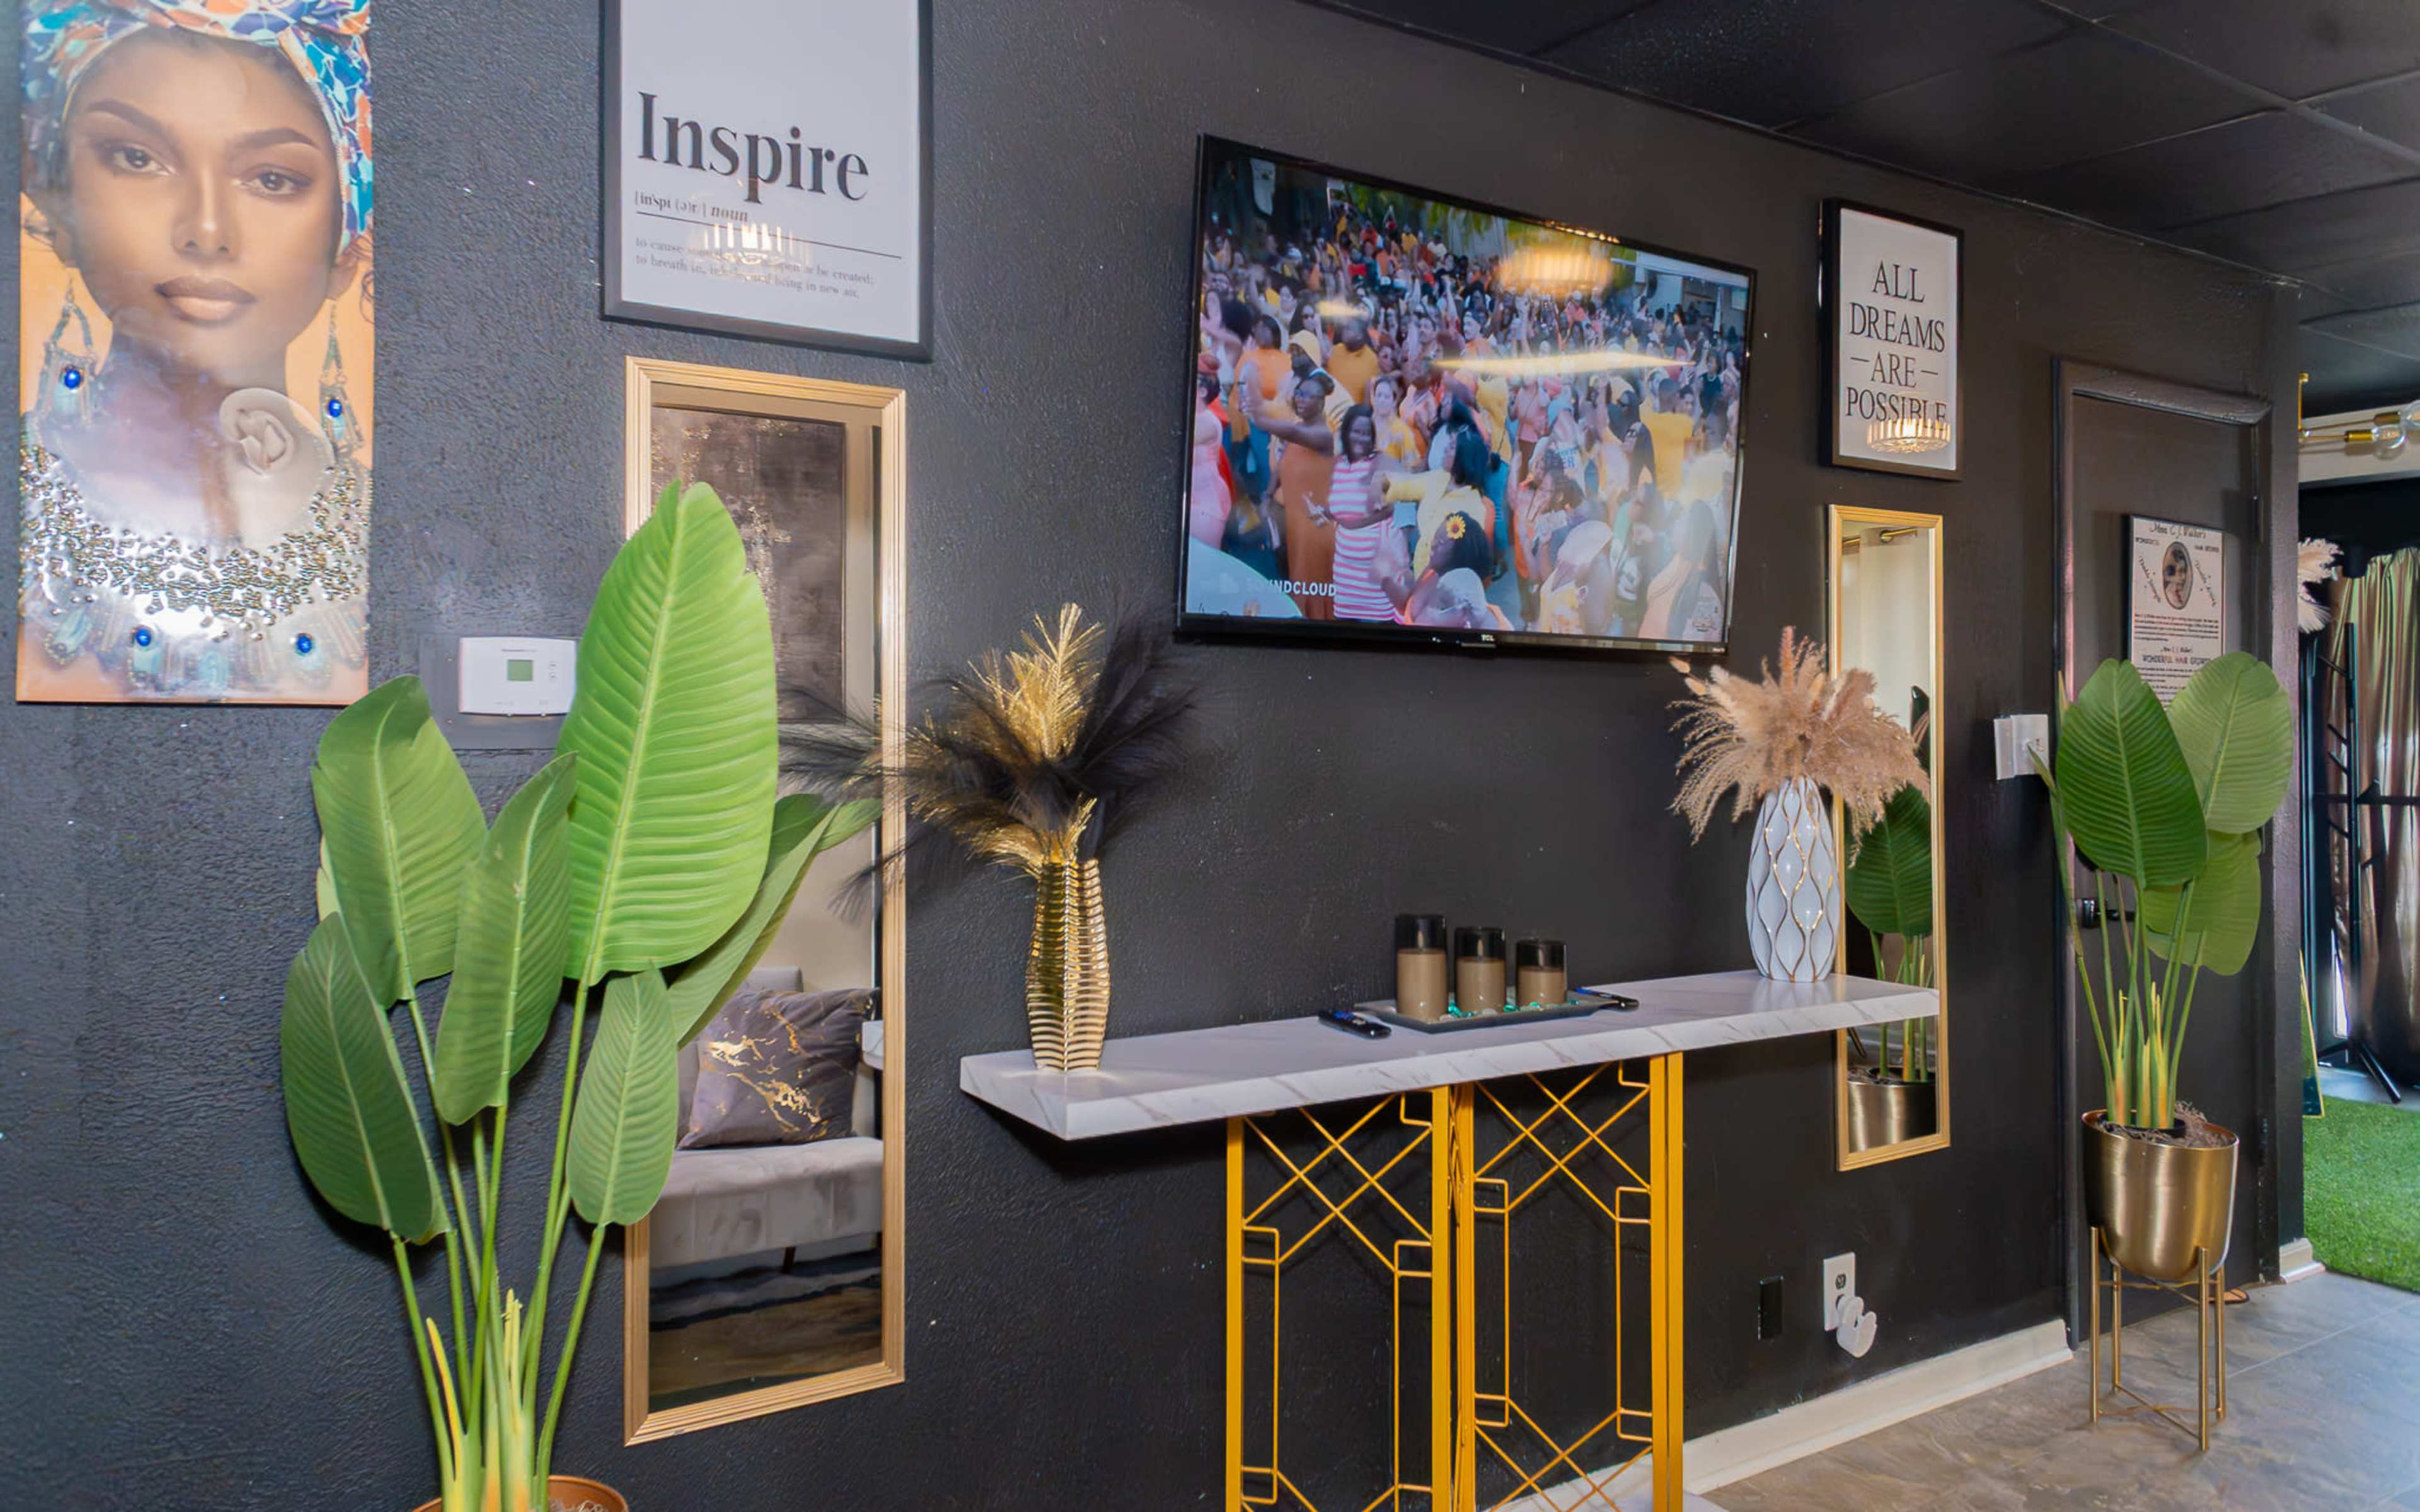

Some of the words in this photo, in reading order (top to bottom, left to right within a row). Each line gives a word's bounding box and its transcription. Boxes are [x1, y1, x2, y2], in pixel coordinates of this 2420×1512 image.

[638, 91, 869, 204] Inspire
[712, 207, 748, 221] noun
[1872, 260, 1925, 303] ALL
[1850, 302, 1945, 352] DREAMS
[1870, 351, 1916, 389] ARE
[1845, 387, 1947, 430] POSSIBLE
